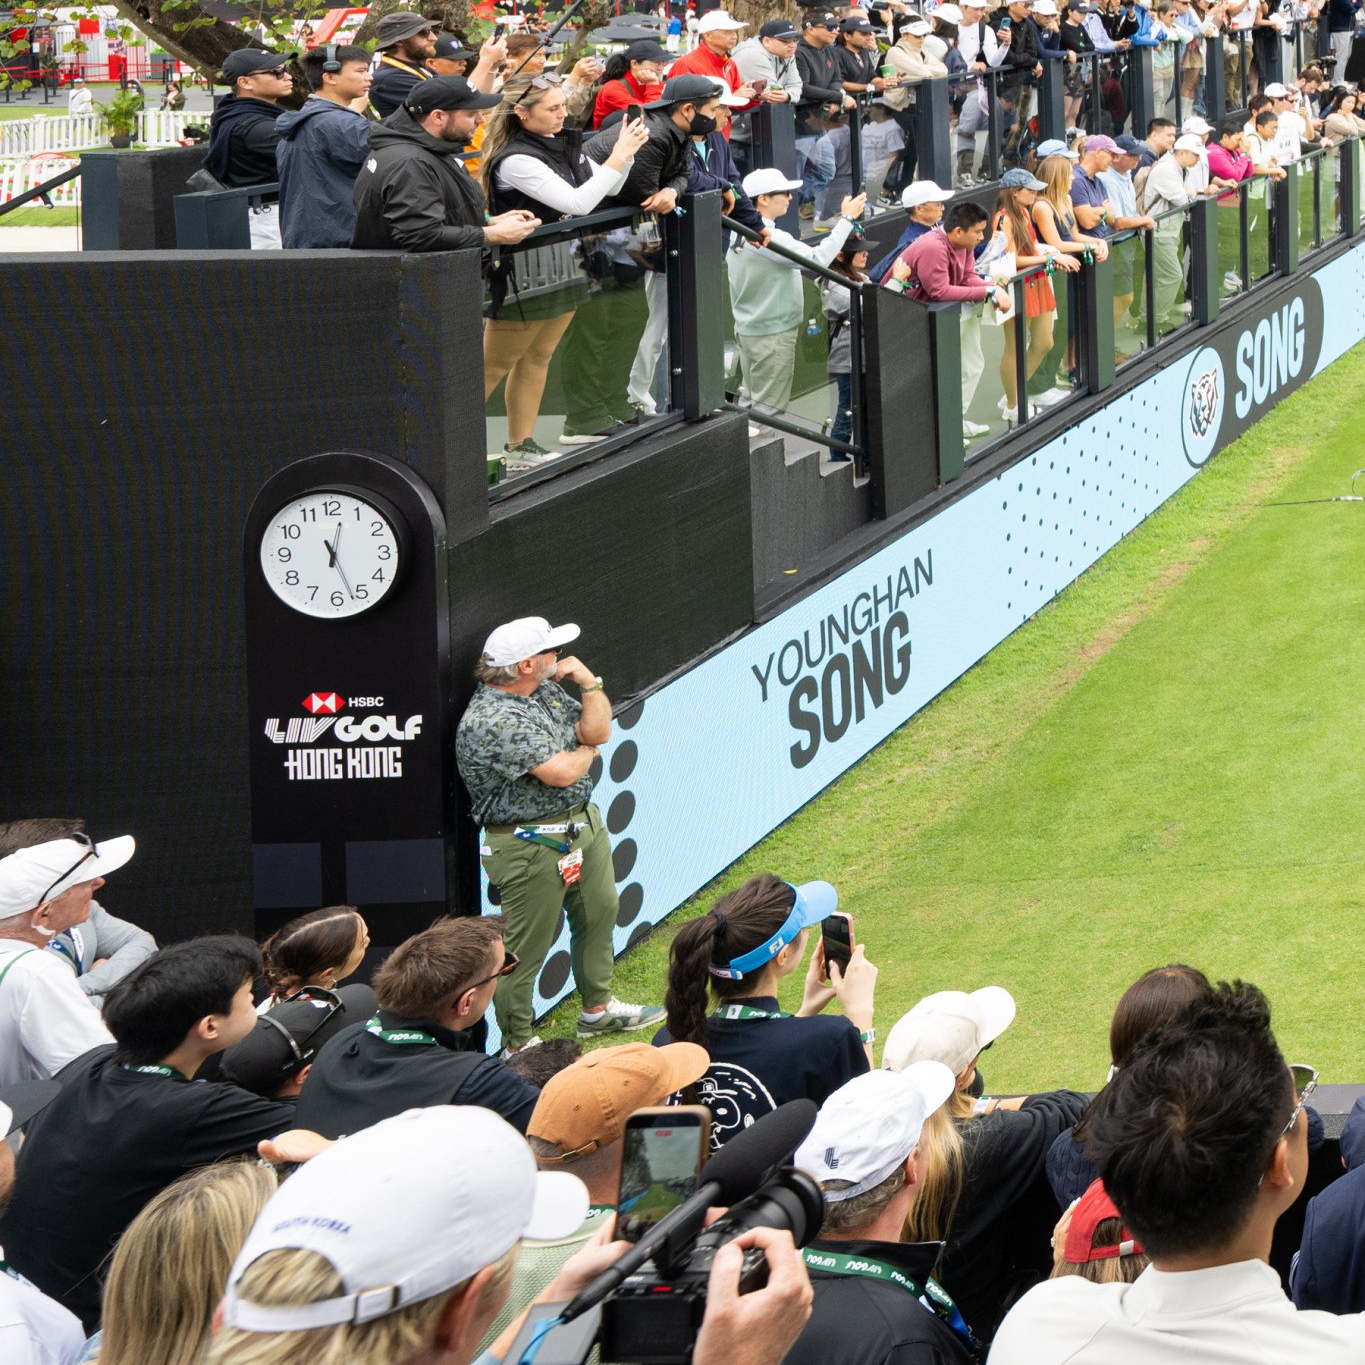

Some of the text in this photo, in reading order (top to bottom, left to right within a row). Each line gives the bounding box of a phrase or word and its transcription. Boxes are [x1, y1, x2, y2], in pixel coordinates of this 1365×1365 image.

[1235, 296, 1305, 420] SONG
[300, 508, 317, 523] 11
[322, 501, 341, 516] 12
[354, 507, 361, 521] 1
[281, 524, 301, 539] 10
[371, 522, 384, 537] 2
[278, 547, 292, 562] 9
[377, 545, 391, 560] 3
[285, 570, 300, 585] 8
[372, 568, 385, 583] 4
[306, 586, 319, 601] 7
[330, 591, 344, 606] 6
[356, 584, 369, 600] 5
[751, 548, 934, 702] YOUNGHAN
[789, 611, 912, 769] SONG
[348, 697, 385, 708] HSBC
[264, 715, 423, 744] LIV GOLF
[284, 746, 402, 780] HONG KONG
[769, 936, 785, 955] FJ
